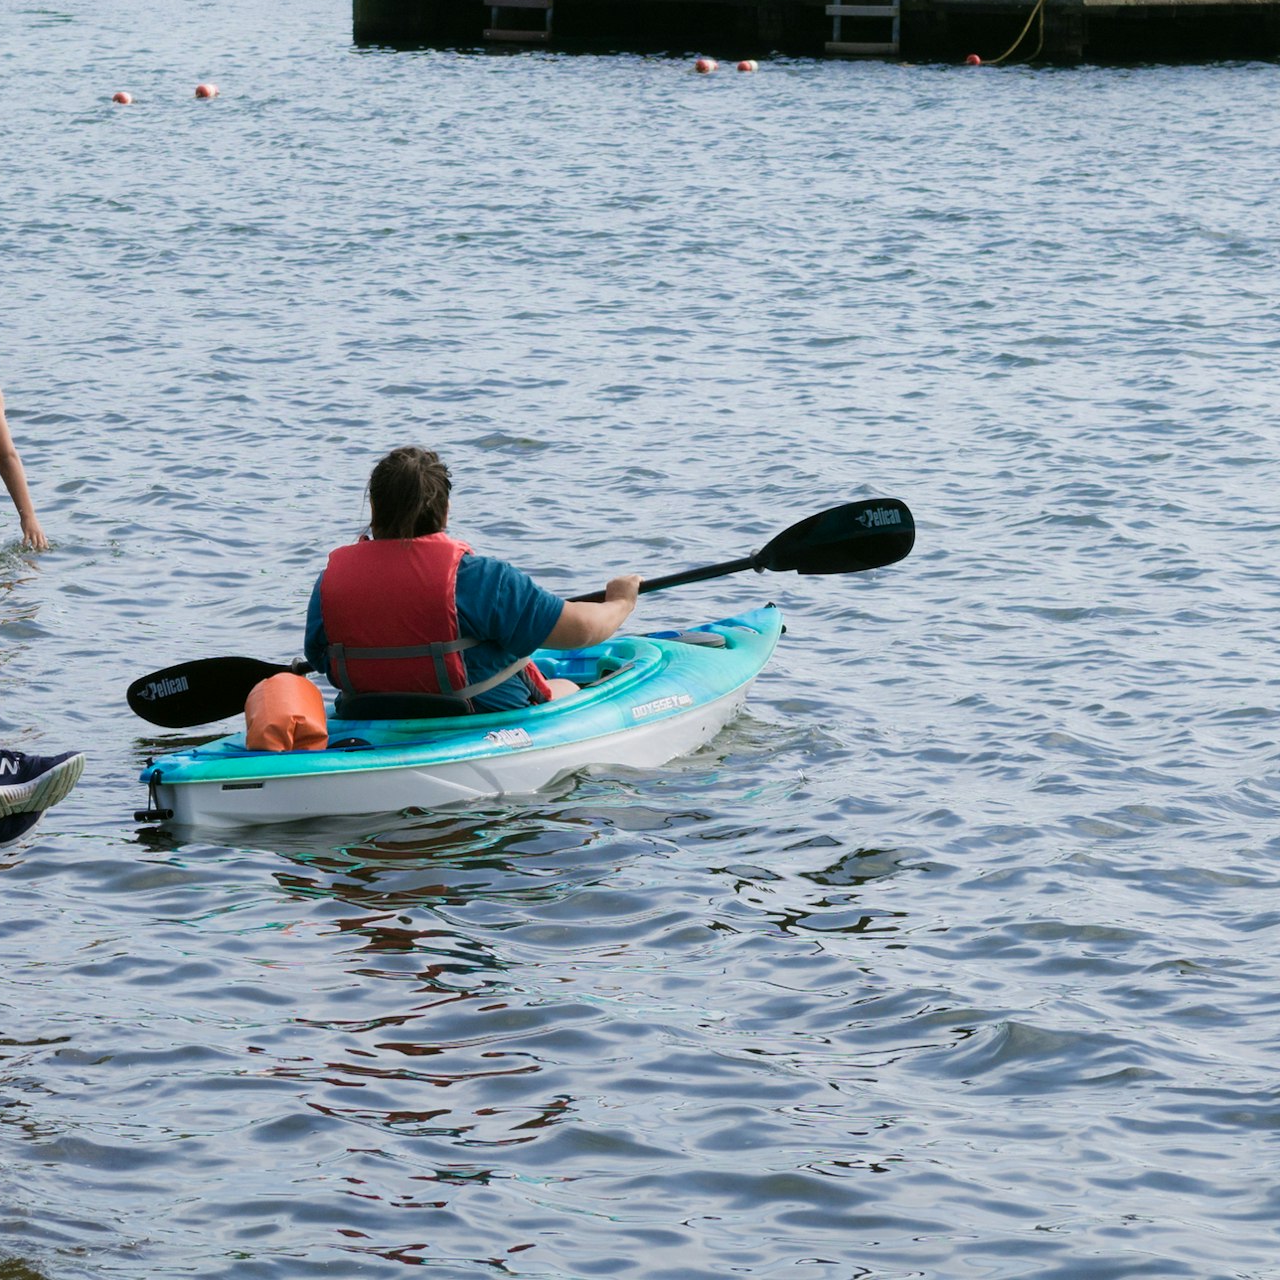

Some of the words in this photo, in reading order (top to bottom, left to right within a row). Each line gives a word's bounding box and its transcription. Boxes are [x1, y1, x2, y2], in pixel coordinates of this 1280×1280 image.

[863, 507, 901, 528] Pelican
[147, 676, 189, 700] Pelican
[631, 695, 678, 718] ODYSSEY
